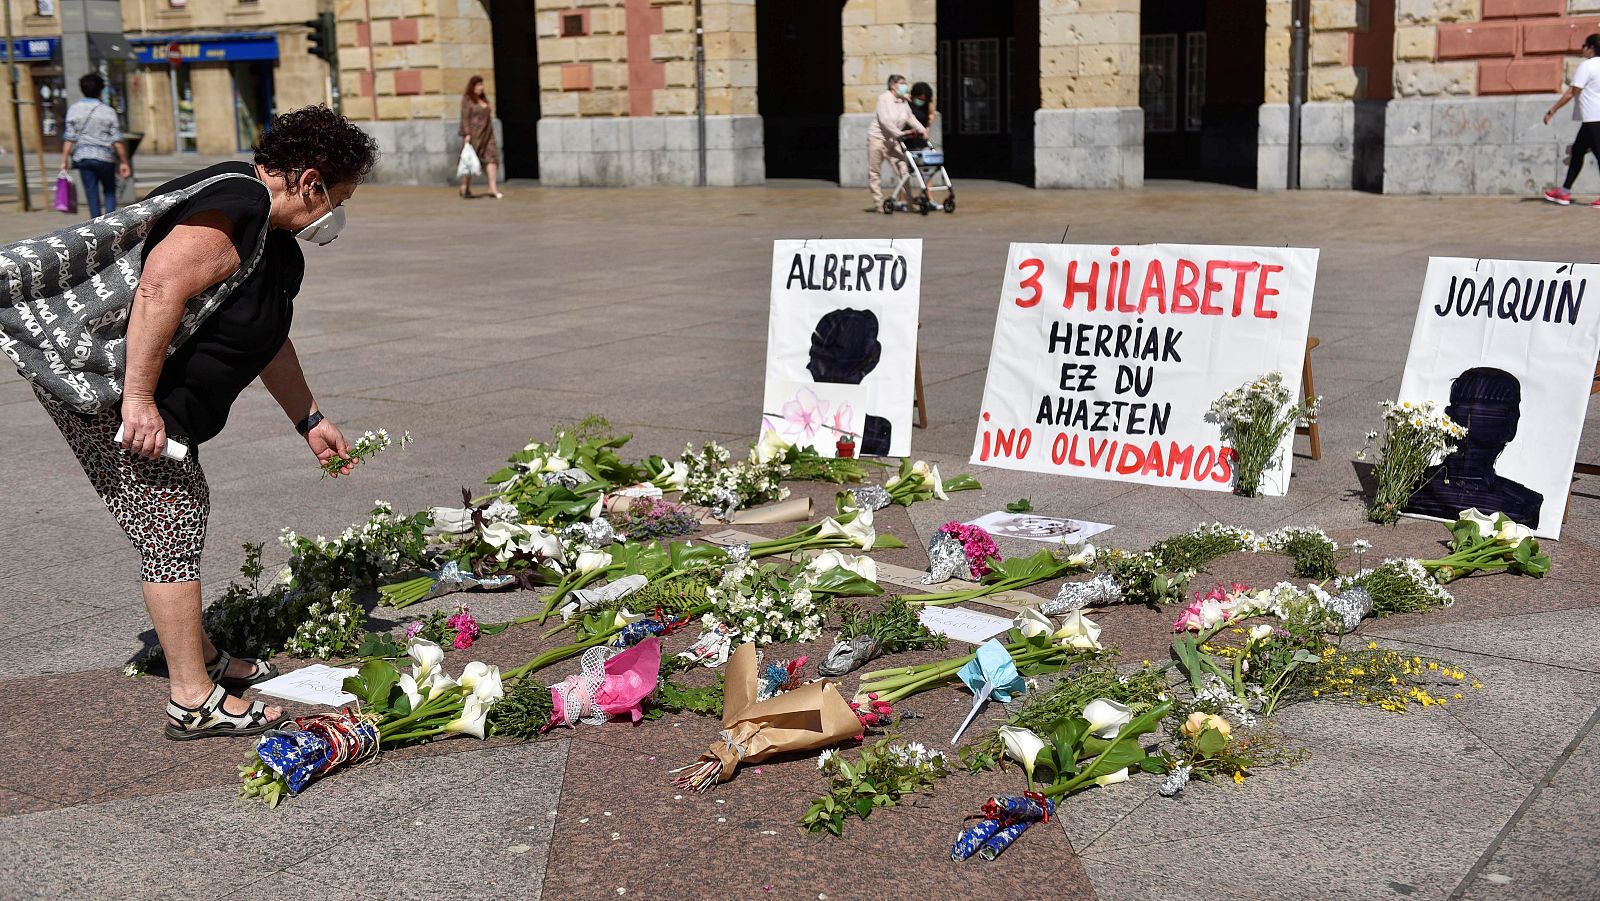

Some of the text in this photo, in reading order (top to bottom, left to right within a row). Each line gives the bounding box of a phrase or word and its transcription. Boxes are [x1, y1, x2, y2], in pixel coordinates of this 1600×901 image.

[786, 253, 907, 291] ALBERTO
[1015, 247, 1284, 318] 3 HILABETE
[1434, 265, 1587, 325] JOAQUÍN
[1048, 318, 1183, 362] HERRIAK
[1060, 363, 1153, 398] EZ DU
[1036, 395, 1171, 436] AHAZTEN
